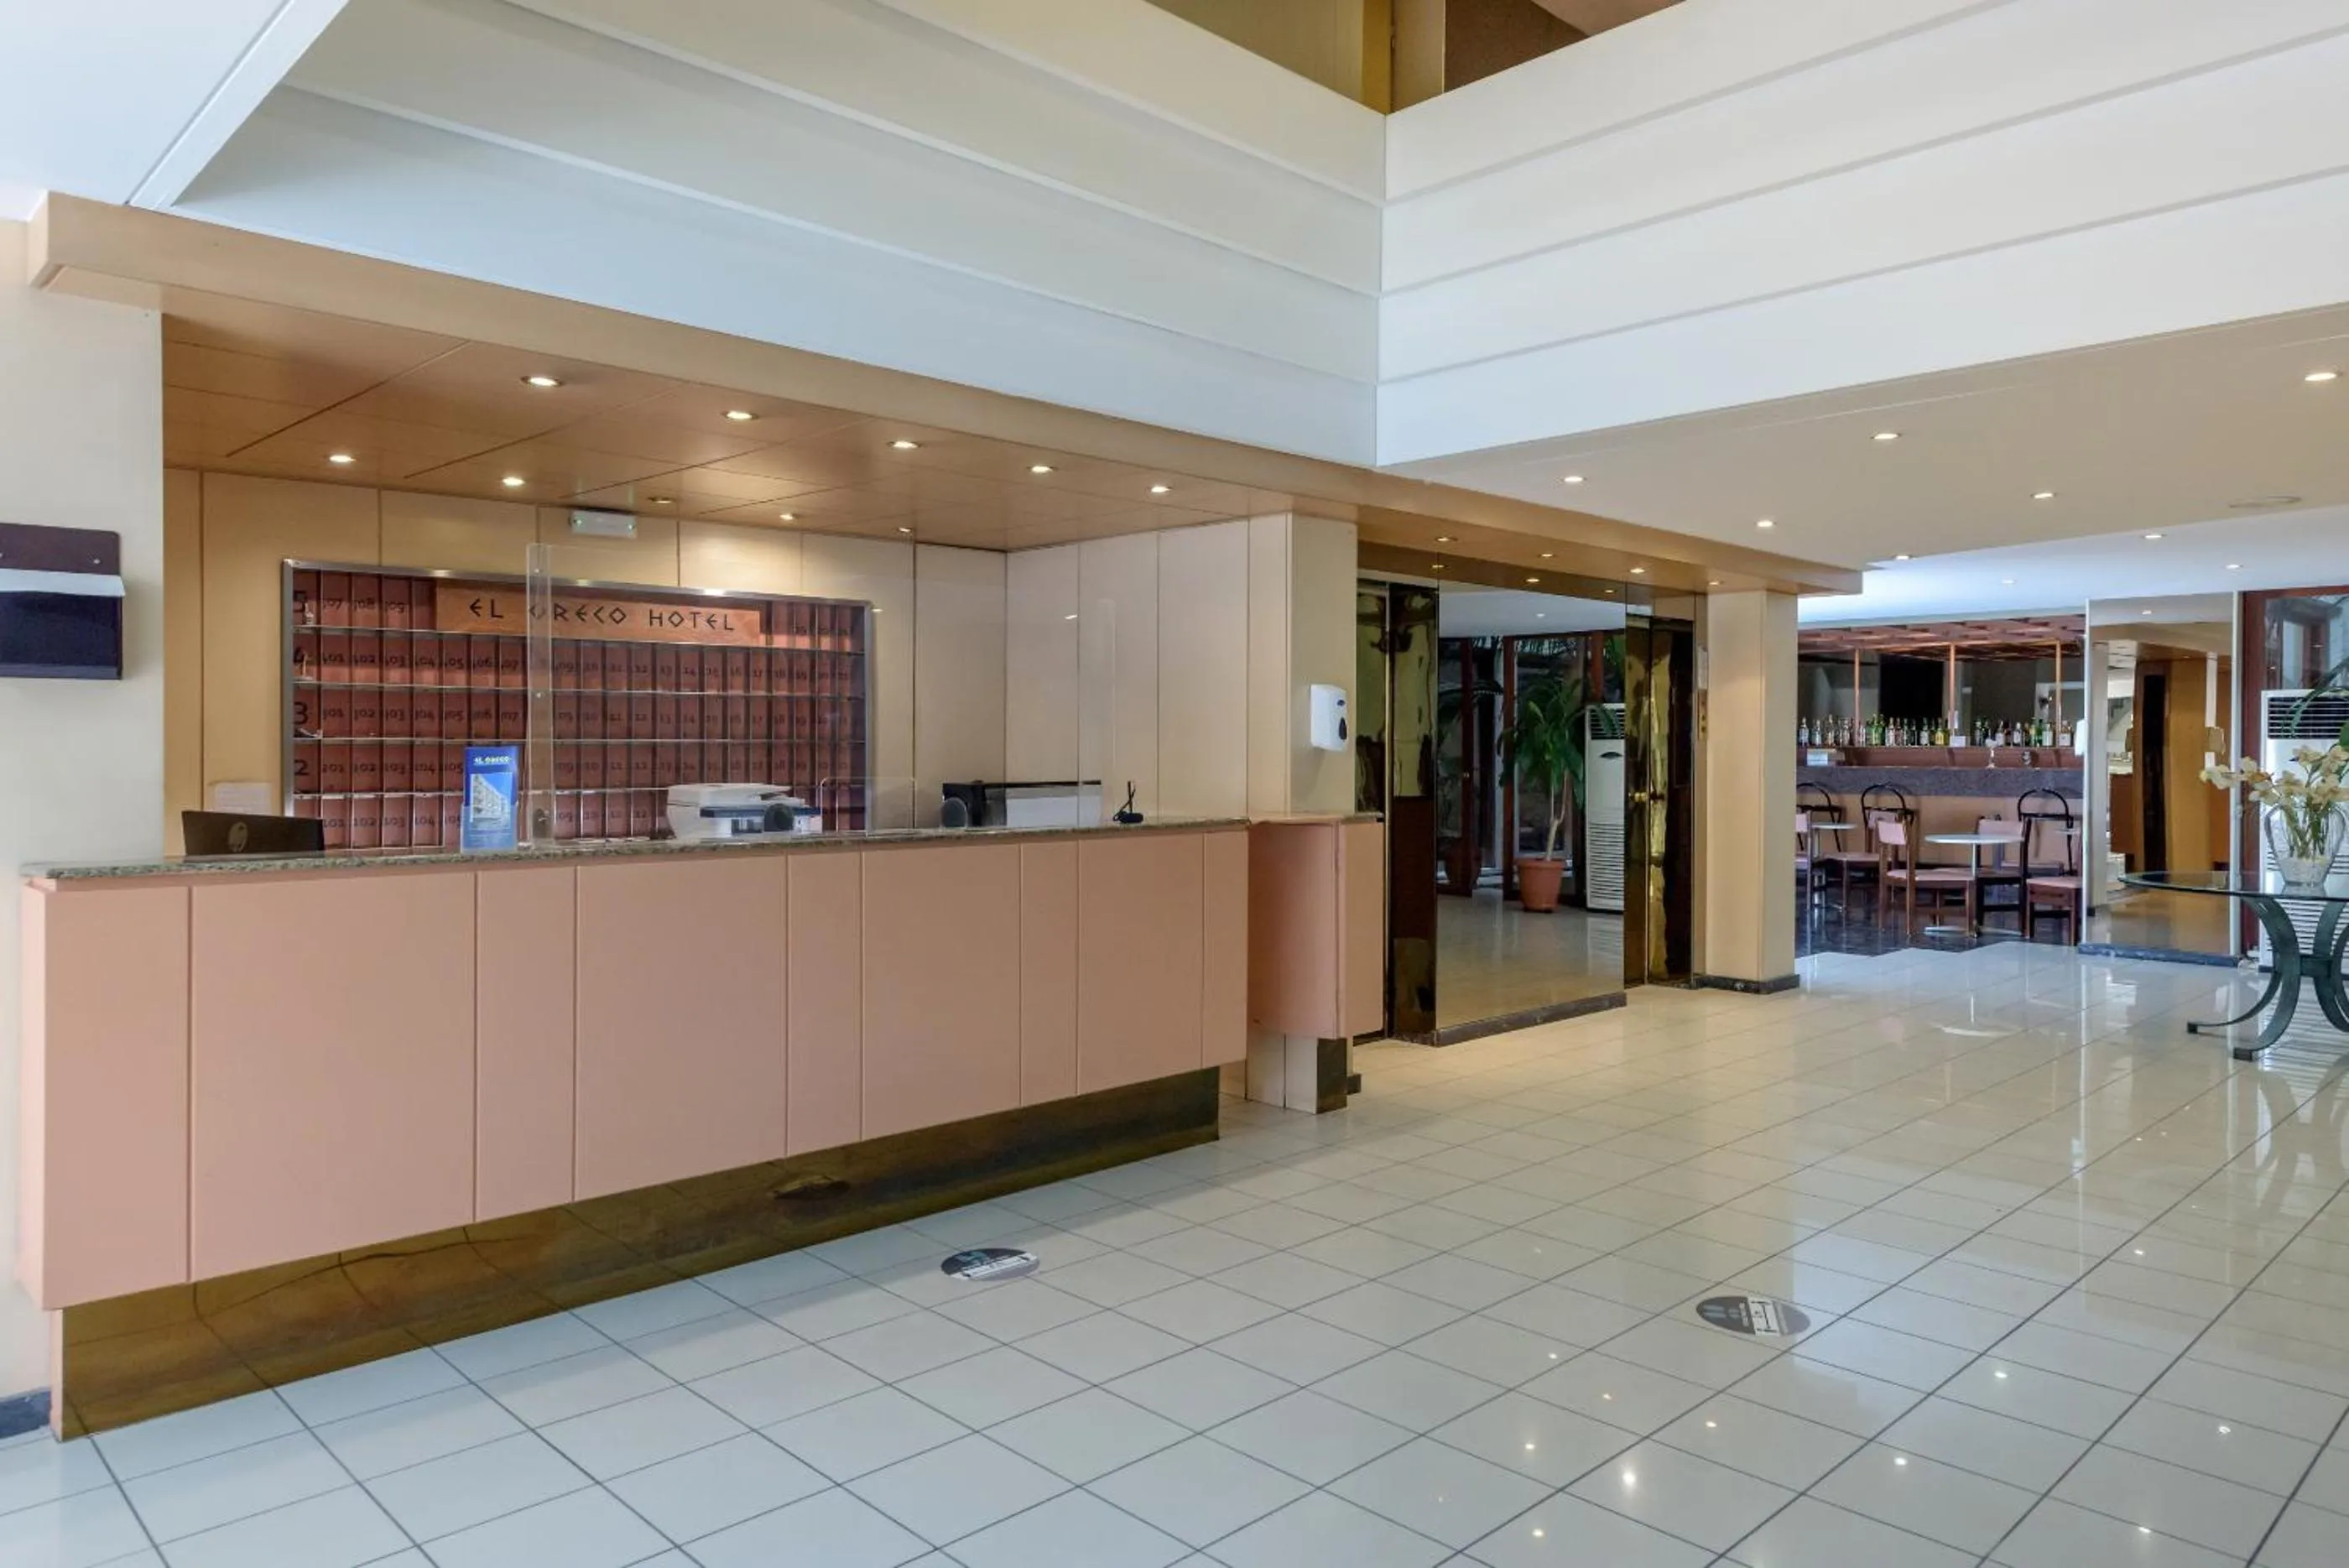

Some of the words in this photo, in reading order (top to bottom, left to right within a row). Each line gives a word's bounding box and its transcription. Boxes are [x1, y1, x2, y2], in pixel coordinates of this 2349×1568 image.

[469, 597, 504, 619] EL
[648, 608, 736, 632] HOTEL
[294, 701, 309, 725] 3
[294, 758, 310, 776] 2
